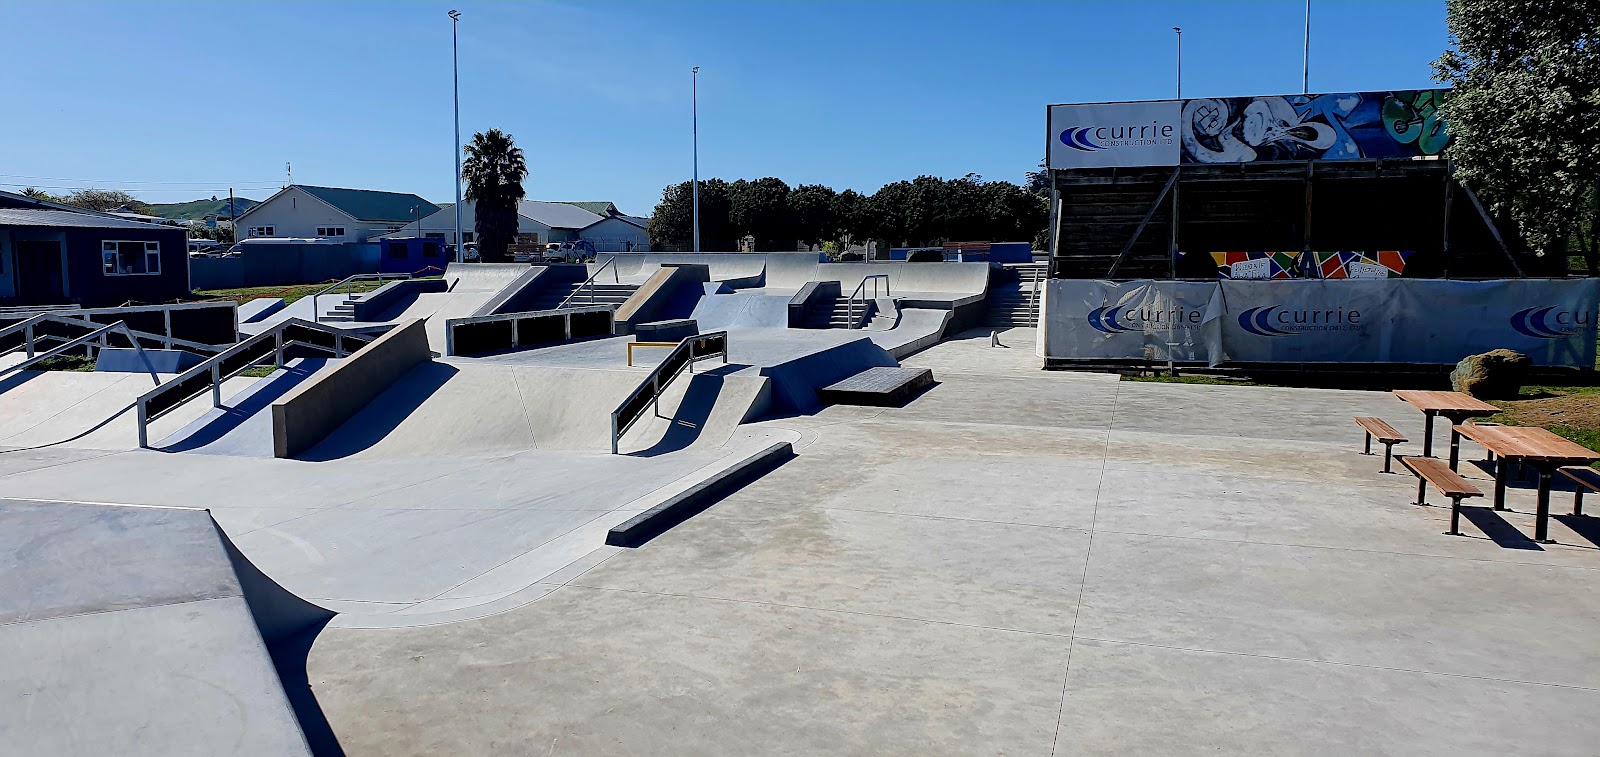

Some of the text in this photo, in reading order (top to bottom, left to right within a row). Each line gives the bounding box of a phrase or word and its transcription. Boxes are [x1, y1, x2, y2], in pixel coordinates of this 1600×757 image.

[1095, 121, 1173, 139] currie
[1126, 306, 1201, 324] currie
[1277, 306, 1361, 324] currie
